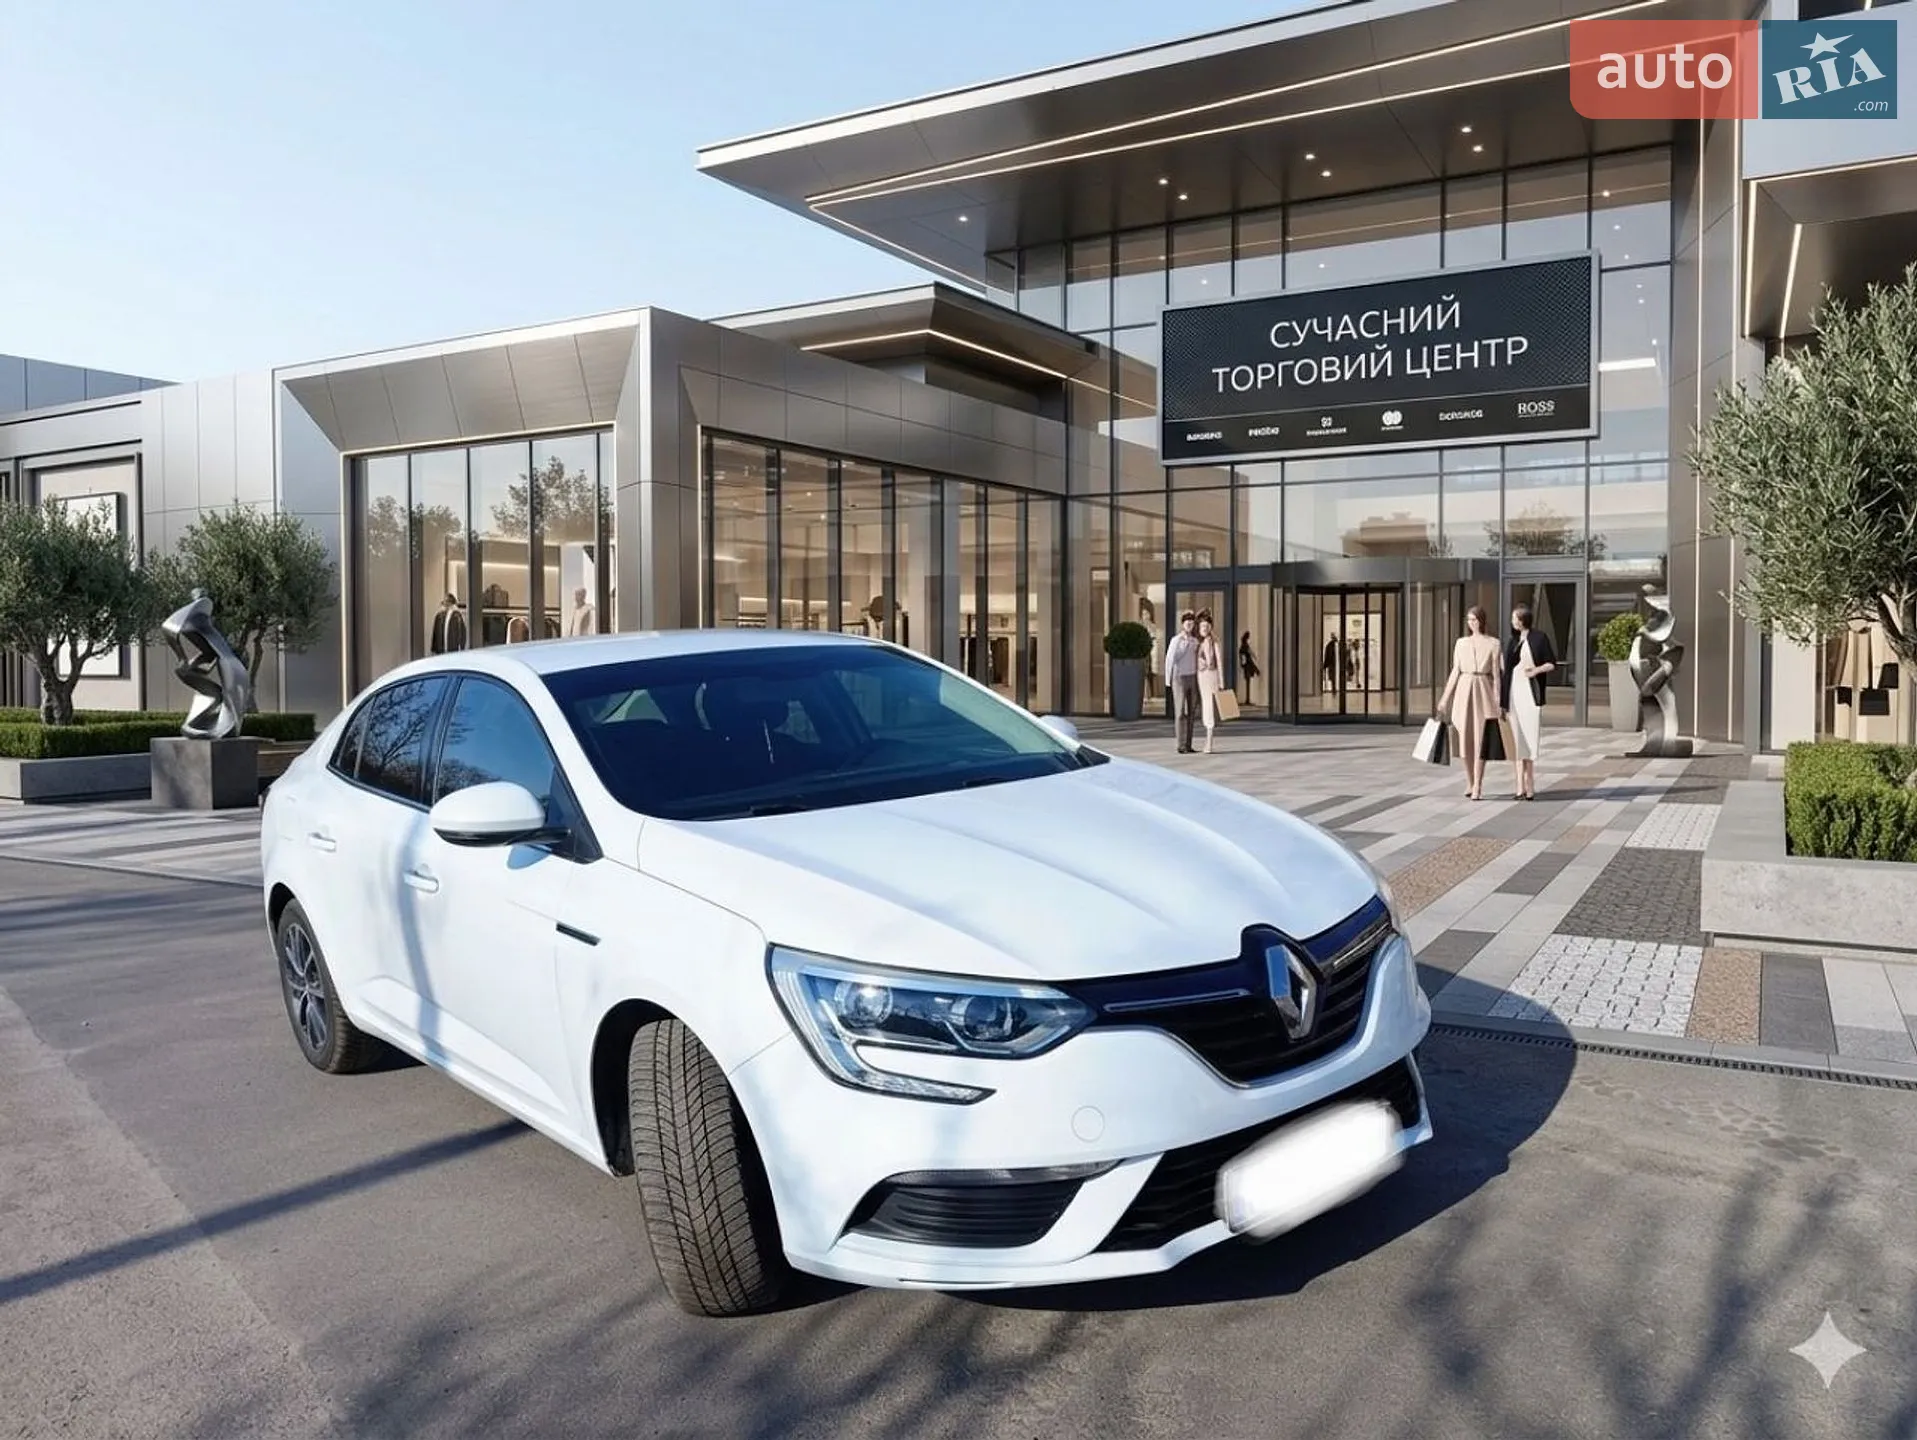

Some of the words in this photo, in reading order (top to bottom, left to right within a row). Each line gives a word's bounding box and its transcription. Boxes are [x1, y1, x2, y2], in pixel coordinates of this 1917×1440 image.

[1269, 294, 1462, 349] СУЧАСНИЙ
[1211, 344, 1393, 393] ТОРГОВИЙ
[1405, 336, 1529, 380] ЦЕНТР
